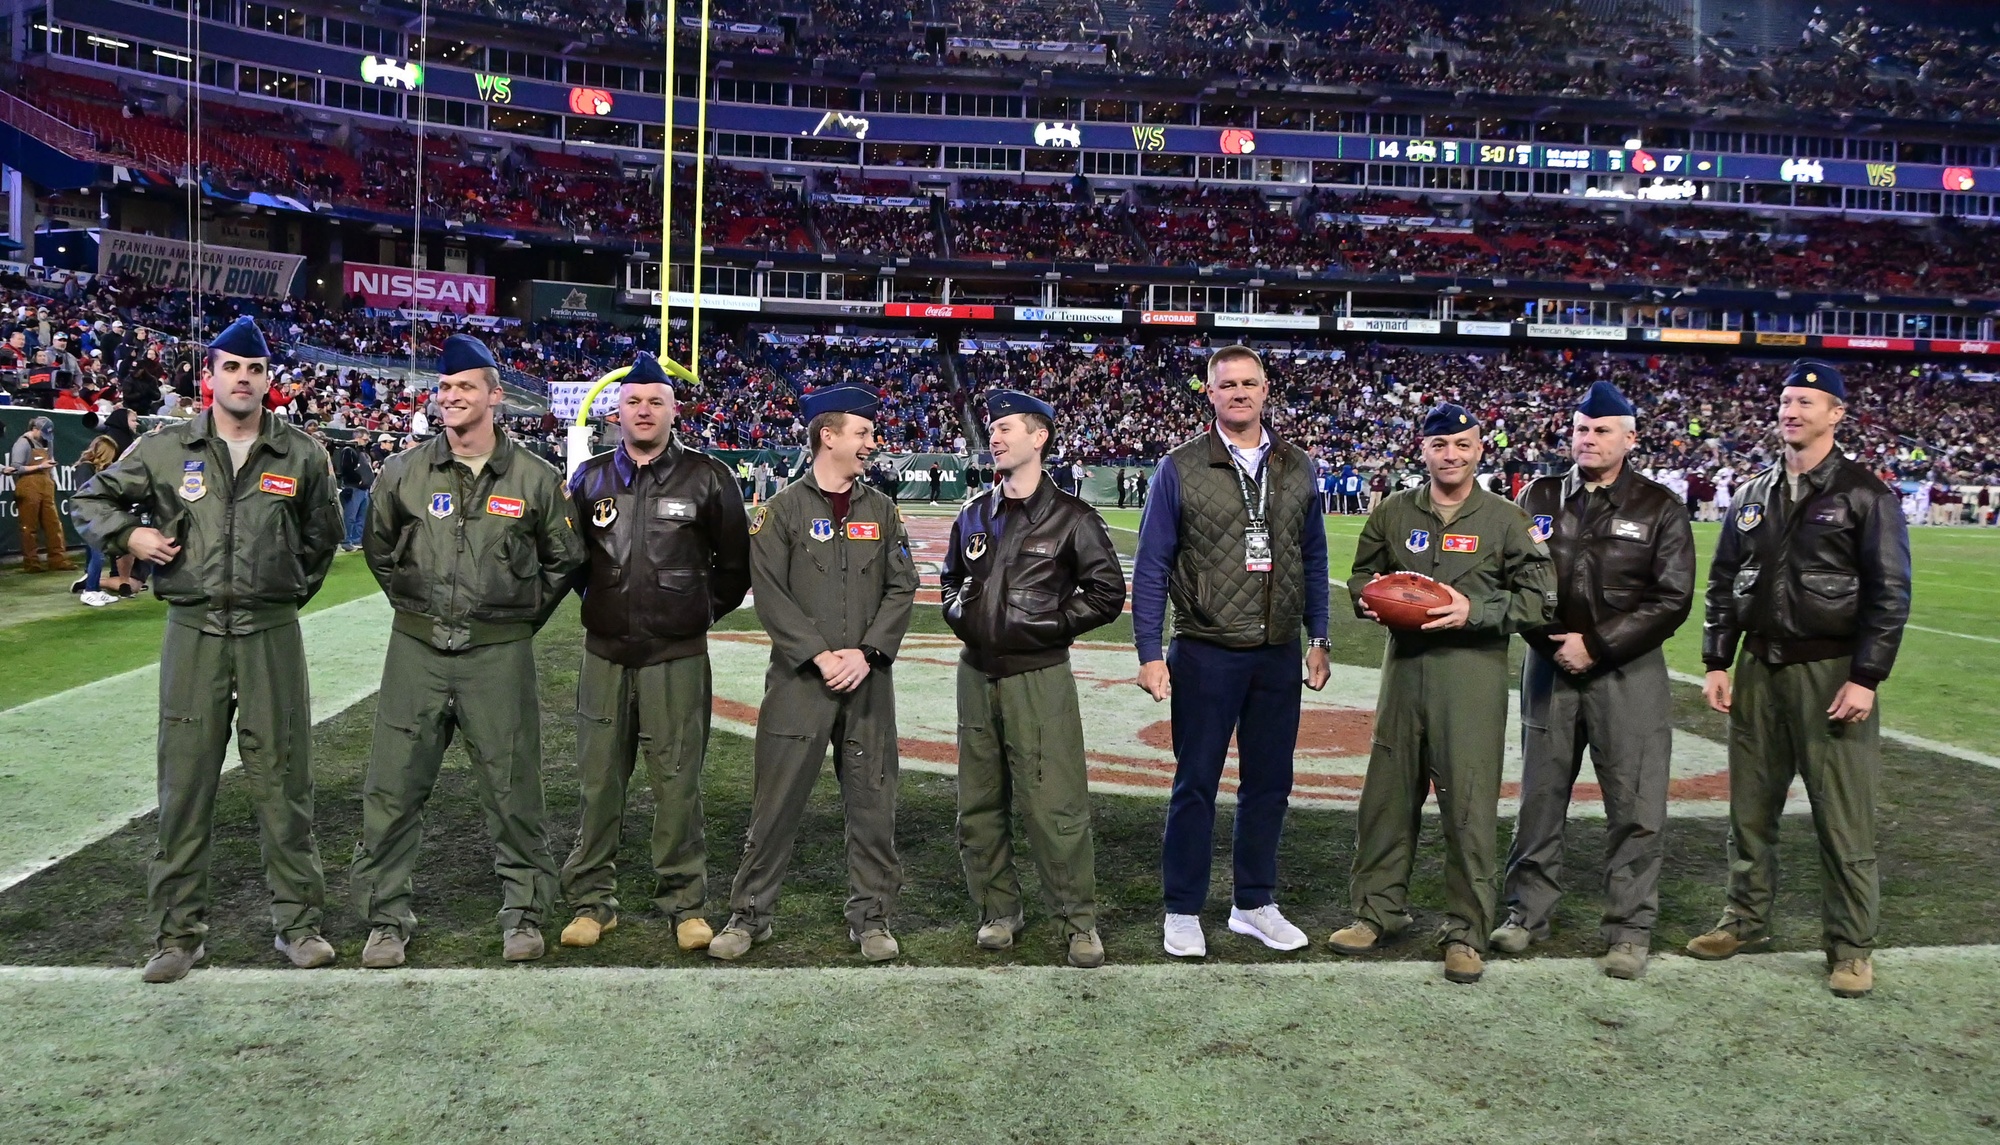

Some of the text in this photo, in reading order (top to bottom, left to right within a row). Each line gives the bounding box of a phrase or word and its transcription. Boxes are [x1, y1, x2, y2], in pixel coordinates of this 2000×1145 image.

[474, 72, 512, 104] VS
[1131, 125, 1165, 151] VS
[1379, 141, 1399, 158] 14
[1480, 145, 1515, 163] 5:01
[1865, 163, 1897, 187] VS
[112, 239, 285, 271] FRANKLIN AMERICAN MORTGAGE
[106, 252, 280, 297] MUSIC CITY BOWL
[353, 270, 486, 304] NISSAN
[1044, 311, 1114, 322] of Tennessee
[1153, 314, 1195, 323] GATORADE
[1366, 319, 1408, 332] Maynard
[1529, 326, 1562, 335] American
[1564, 327, 1585, 337] Paper
[1592, 328, 1612, 337] Twine
[1847, 338, 1888, 348] NISSAN
[904, 469, 957, 482] DENAL
